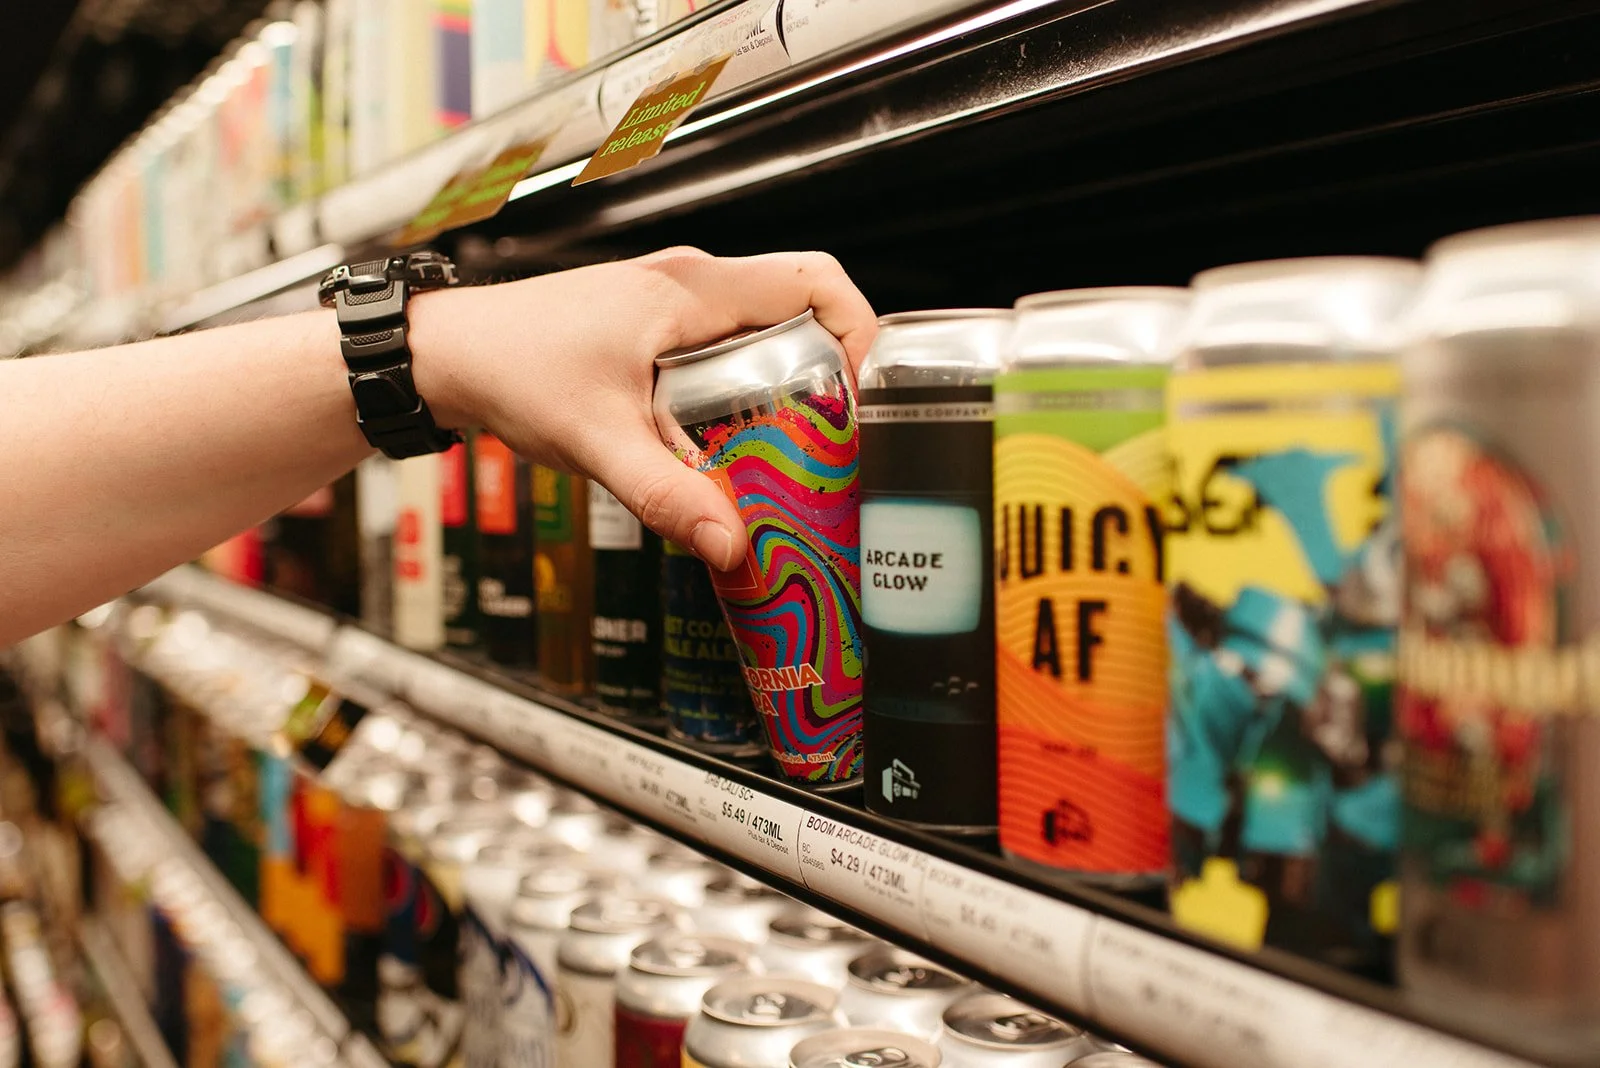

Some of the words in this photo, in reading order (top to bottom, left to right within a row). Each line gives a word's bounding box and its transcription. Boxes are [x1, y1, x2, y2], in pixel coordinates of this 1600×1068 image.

[618, 81, 706, 131] Limited
[600, 120, 677, 158] release
[924, 406, 990, 418] COMPANY
[866, 549, 944, 569] ARCADE
[873, 572, 928, 592] GLOW
[686, 619, 730, 639] COA
[1032, 596, 1107, 684] AF
[721, 801, 746, 824] $5.49
[752, 815, 784, 842] 473ML
[806, 815, 836, 837] BOOM
[836, 827, 879, 853] ARCADE
[879, 841, 911, 864] GLOW
[801, 842, 811, 854] BC
[830, 847, 861, 874] $4.29
[869, 864, 909, 894] 473ML
